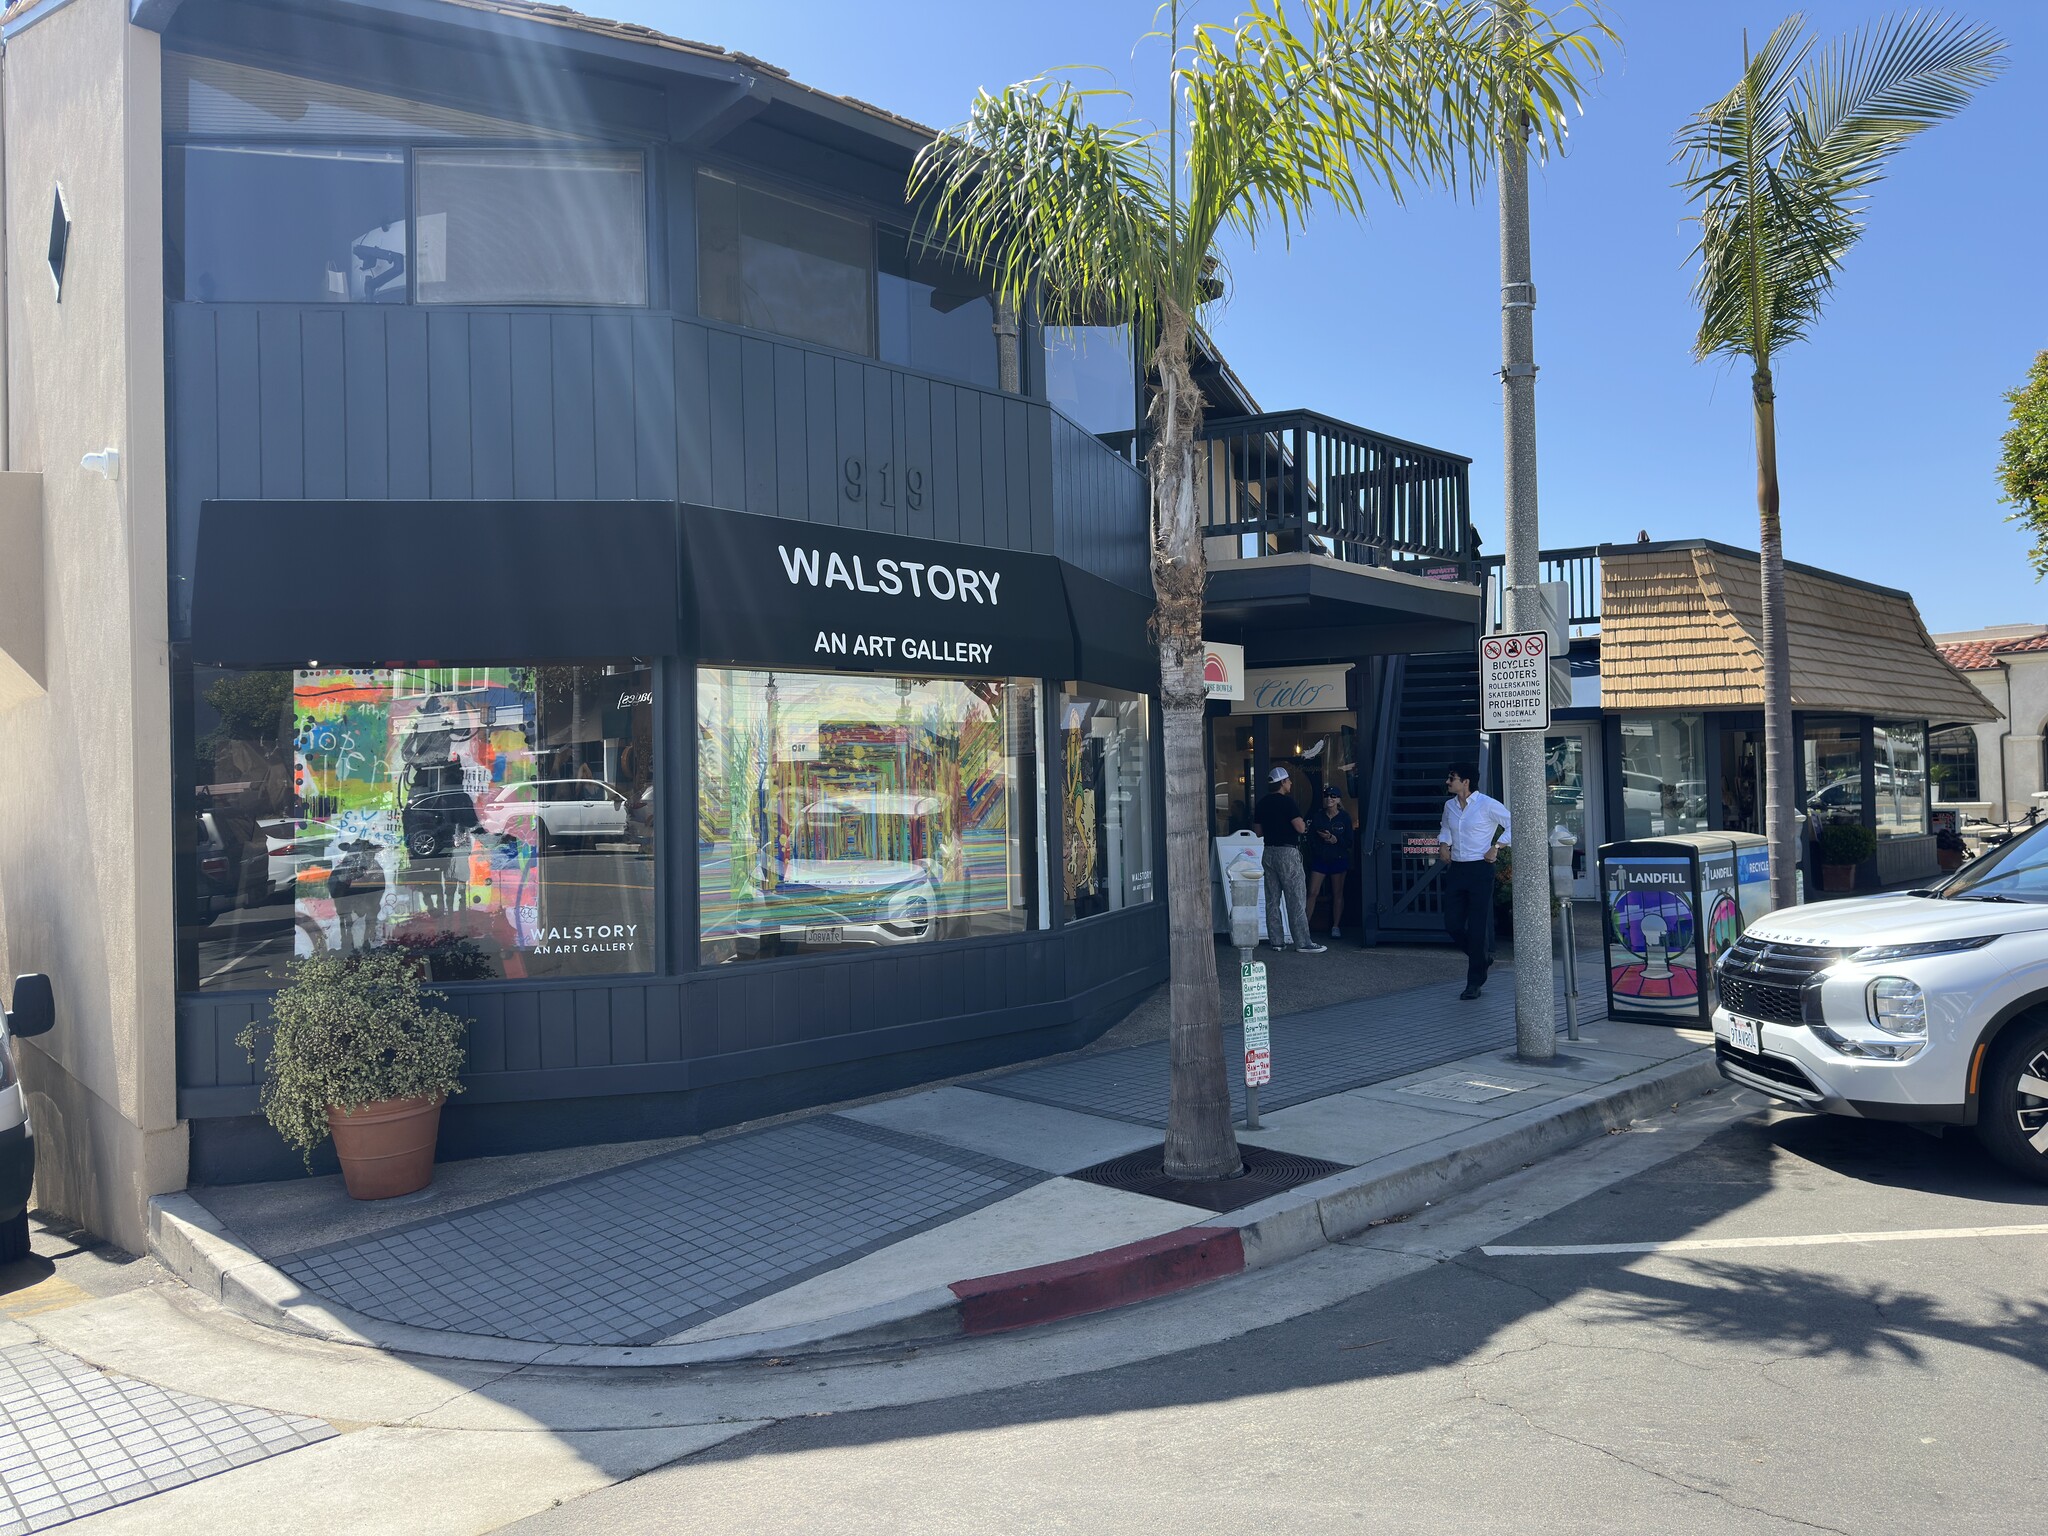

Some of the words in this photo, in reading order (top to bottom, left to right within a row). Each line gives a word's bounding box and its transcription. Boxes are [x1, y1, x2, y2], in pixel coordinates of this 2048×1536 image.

[845, 457, 923, 511] 919
[778, 545, 1000, 605] WALSTORY
[814, 631, 847, 655] AN
[853, 634, 896, 657] ART
[901, 638, 993, 664] GALLERY
[1492, 659, 1535, 670] BICYCLES
[1491, 669, 1537, 681] SCOOTERS
[1488, 680, 1540, 690] ROLLERSKATING
[1253, 678, 1334, 709] Cielo
[1488, 689, 1541, 699] SKATEBOARDING
[1488, 698, 1541, 710] PROHIBITED
[1505, 709, 1537, 717] SIDEWALK
[1709, 866, 1733, 880] LANDFILL
[1749, 860, 1769, 874] RECYCLE
[1628, 872, 1686, 884] LANDFILL
[530, 924, 638, 940] WALSTORY
[1746, 928, 1830, 945] OUTLANDER
[533, 945, 551, 954] AN
[554, 944, 578, 953] ART
[582, 942, 634, 952] GALLERY
[1244, 965, 1249, 976] 2
[1252, 965, 1265, 973] HOUR
[1246, 1005, 1251, 1016] 3
[1254, 1005, 1266, 1013] HOUR
